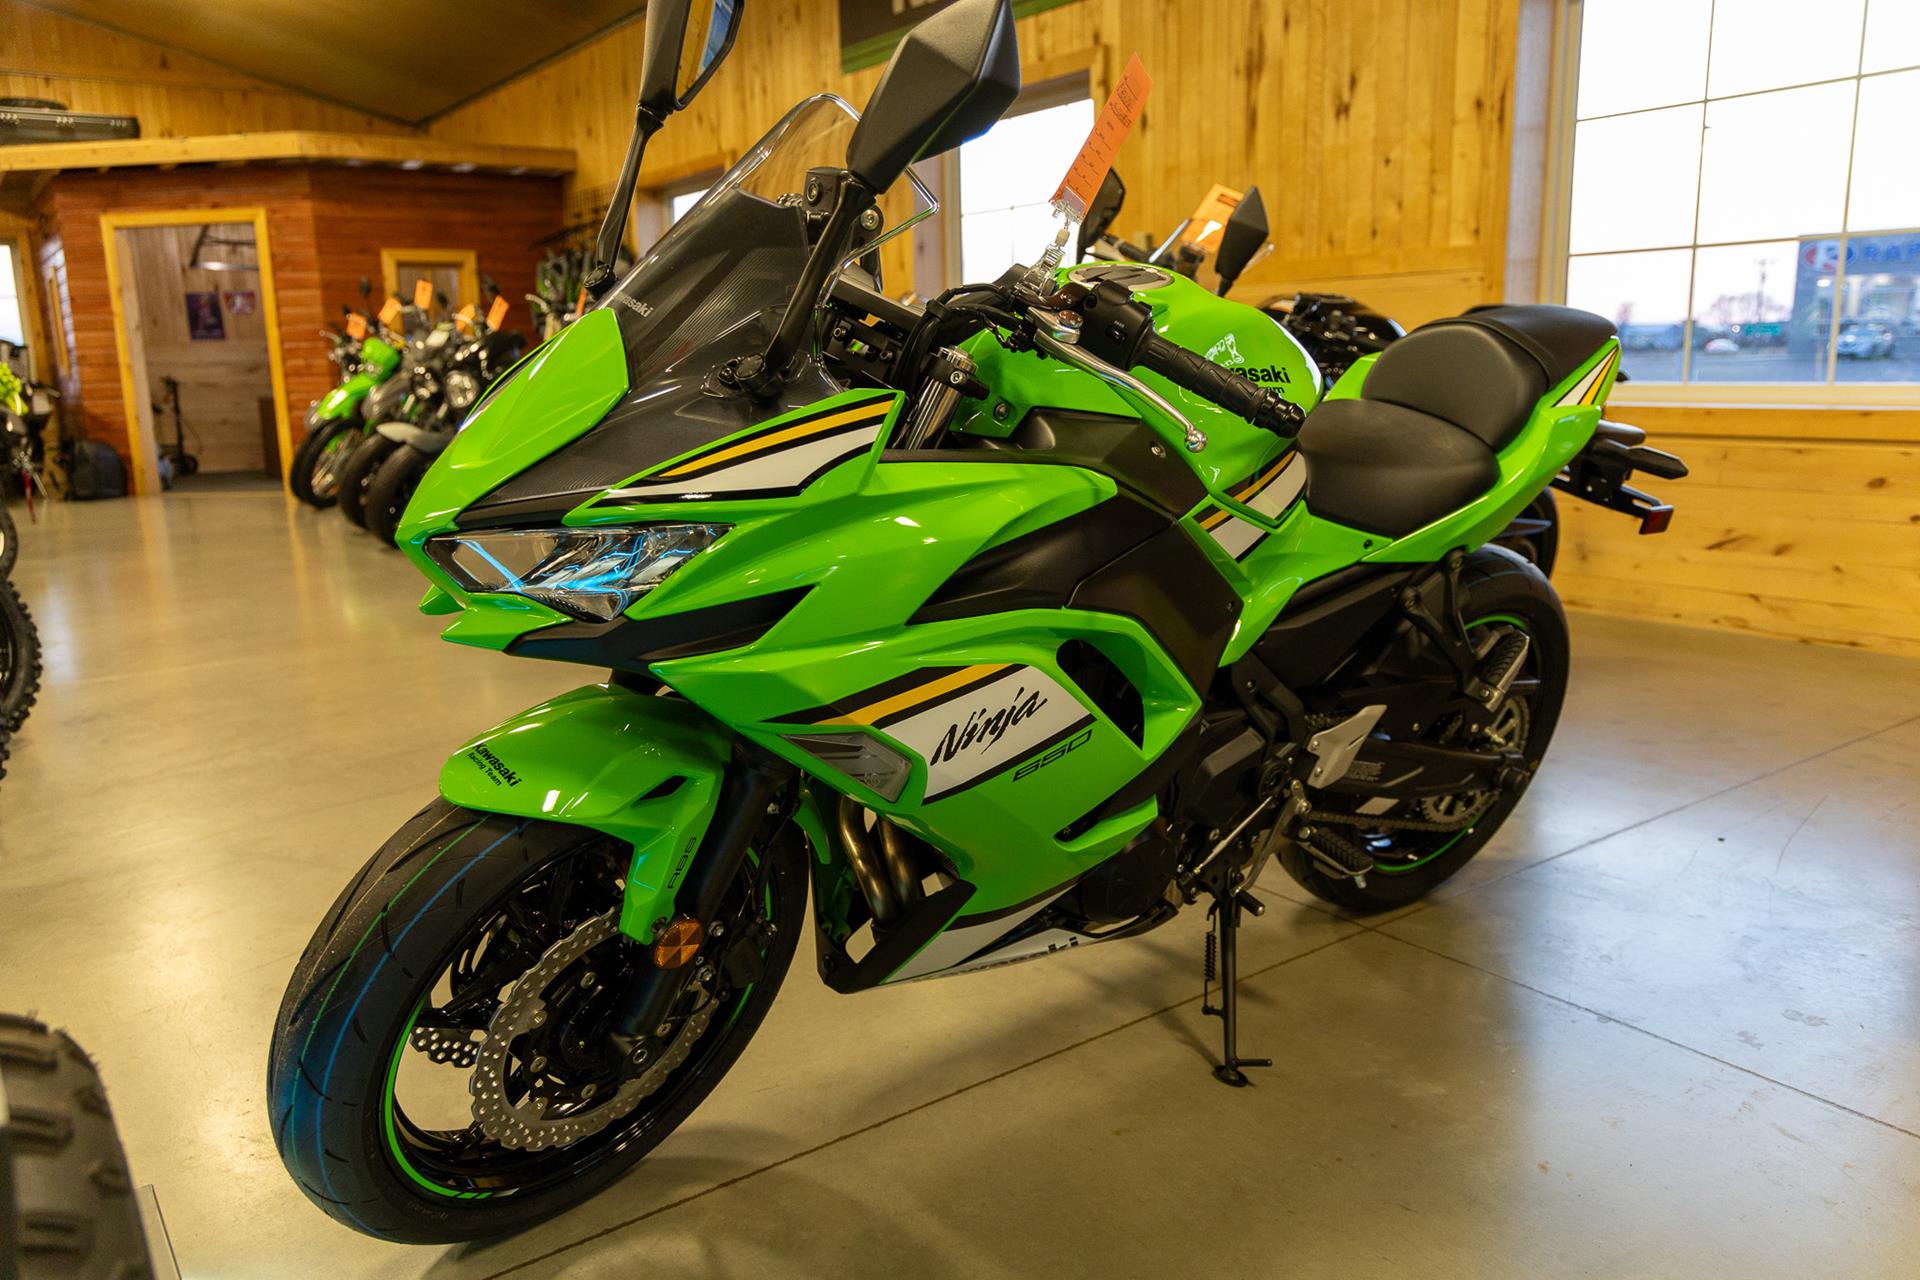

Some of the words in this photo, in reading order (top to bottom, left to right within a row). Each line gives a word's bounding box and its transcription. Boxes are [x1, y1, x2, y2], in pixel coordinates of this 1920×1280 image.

[930, 687, 1048, 766] Ninja
[473, 743, 522, 787] Kawasaki
[485, 767, 502, 786] Team
[1012, 729, 1092, 782] 650
[667, 836, 696, 889] ABS
